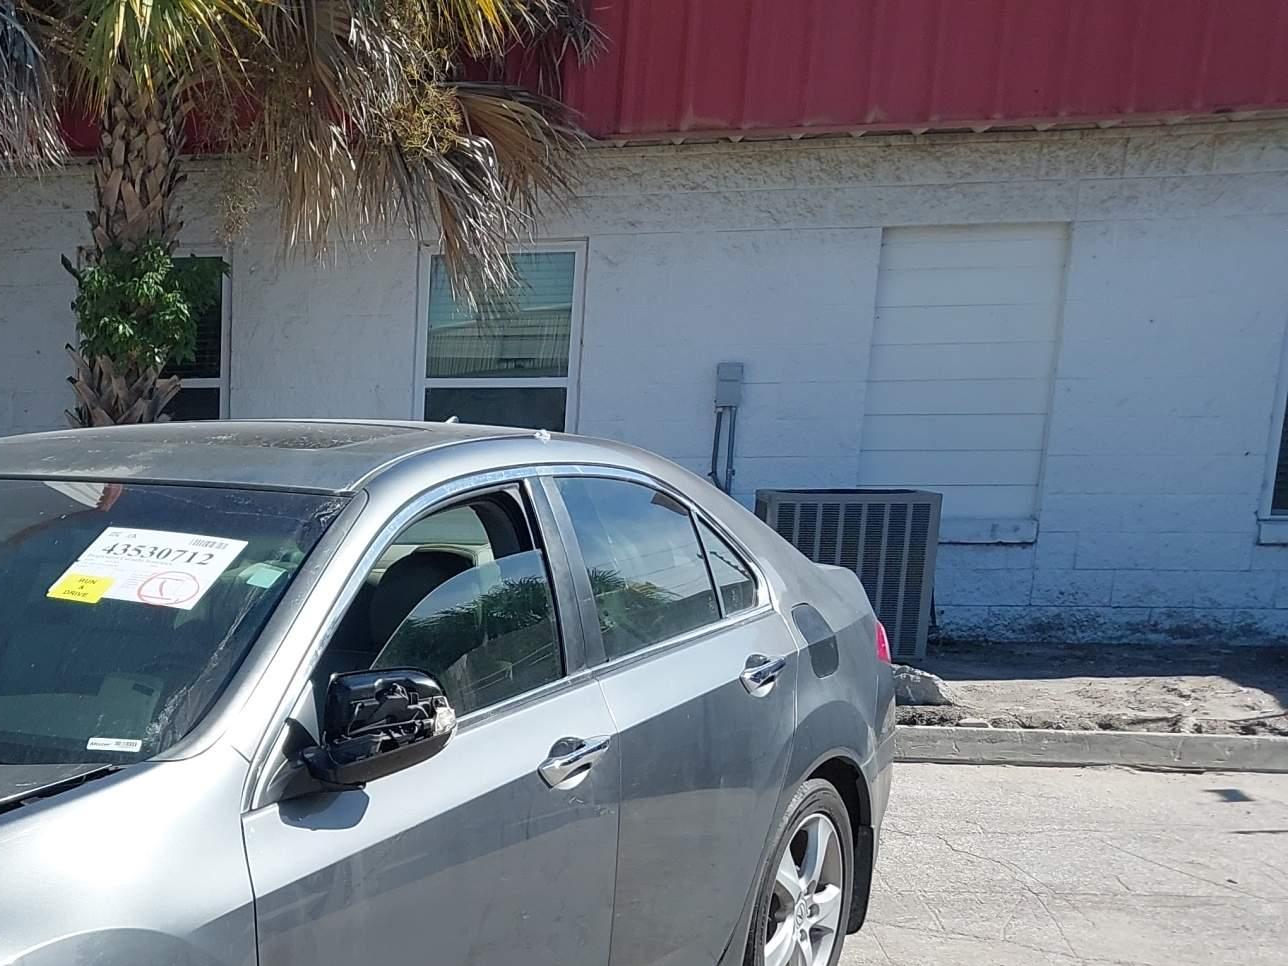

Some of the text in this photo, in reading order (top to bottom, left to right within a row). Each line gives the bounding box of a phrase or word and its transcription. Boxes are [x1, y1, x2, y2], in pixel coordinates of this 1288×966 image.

[102, 542, 214, 566] 43530712
[78, 577, 98, 585] RUN
[62, 589, 89, 597] DRIVE
